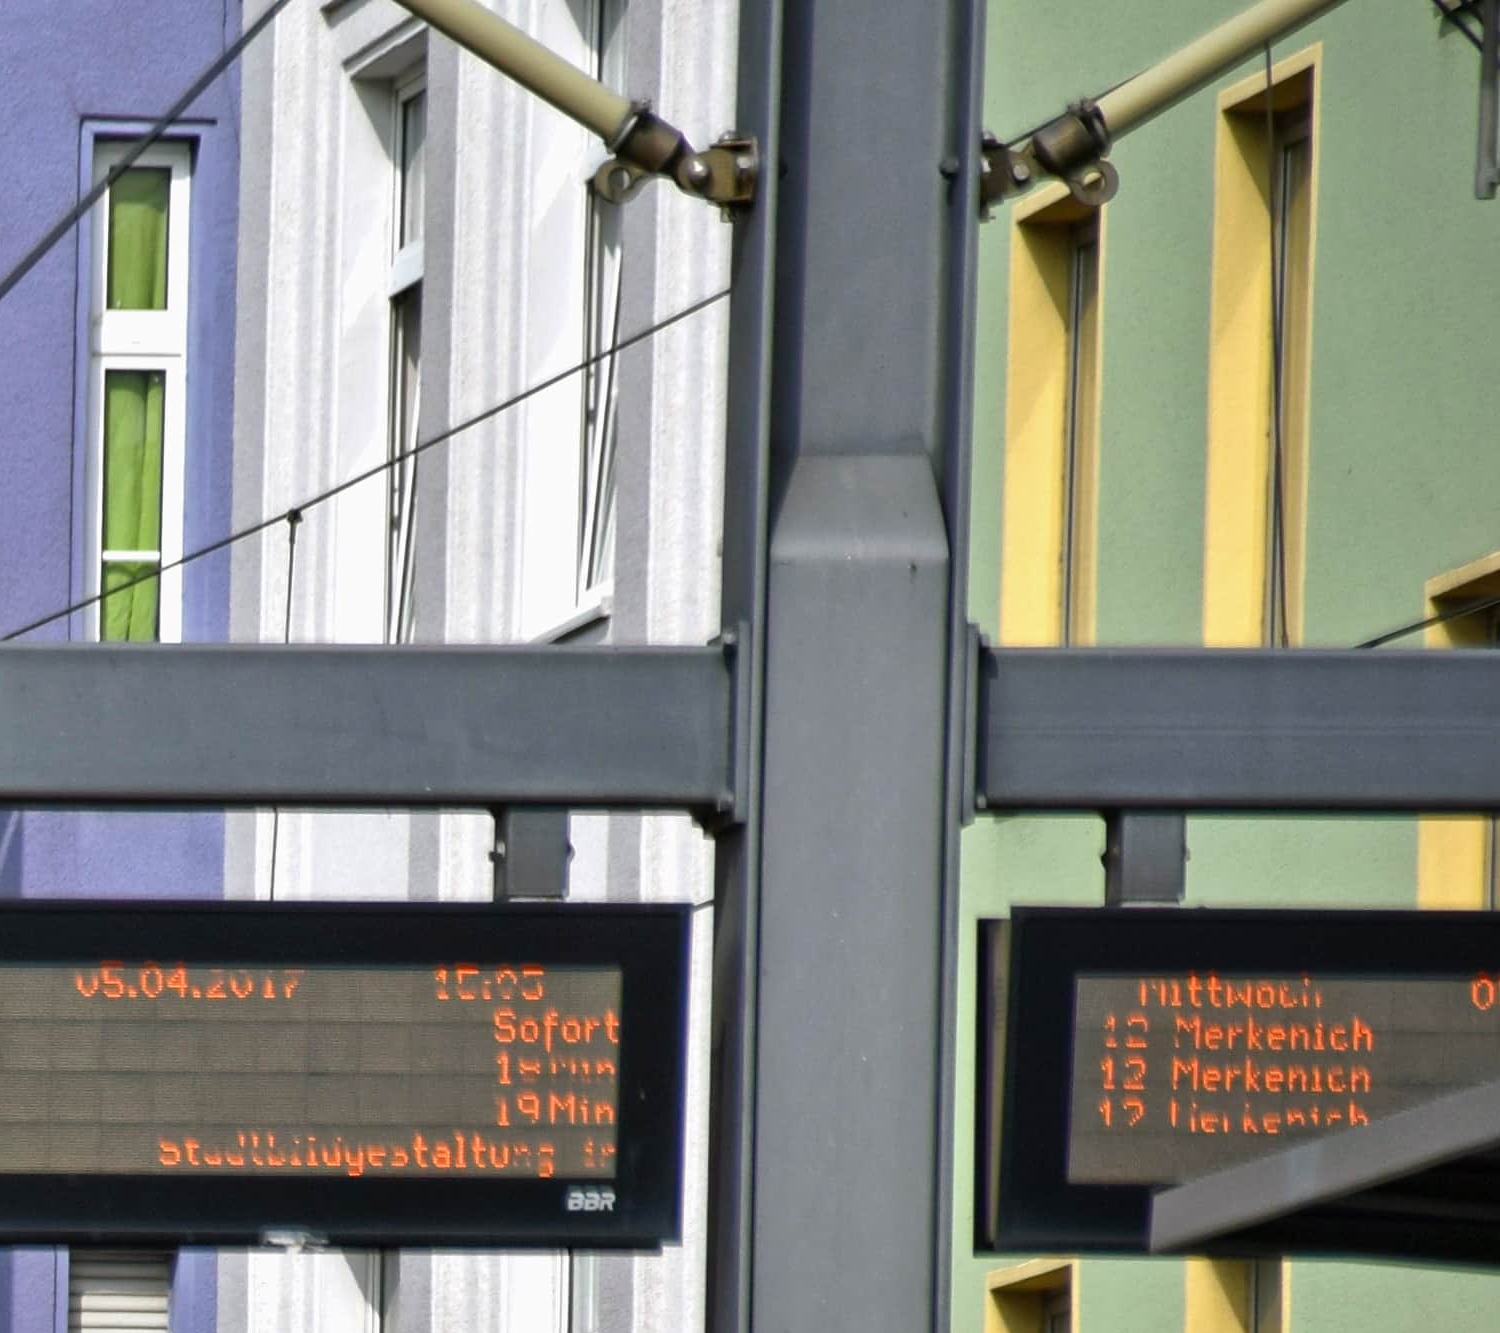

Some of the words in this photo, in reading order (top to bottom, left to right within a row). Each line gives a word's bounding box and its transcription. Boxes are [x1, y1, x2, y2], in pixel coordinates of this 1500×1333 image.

[493, 1006, 619, 1053] Sofort
[1103, 1013, 1148, 1050] 12
[1173, 1013, 1375, 1054] Merkenich
[1099, 1056, 1148, 1092] 12
[1170, 1055, 1372, 1095] Merkenich
